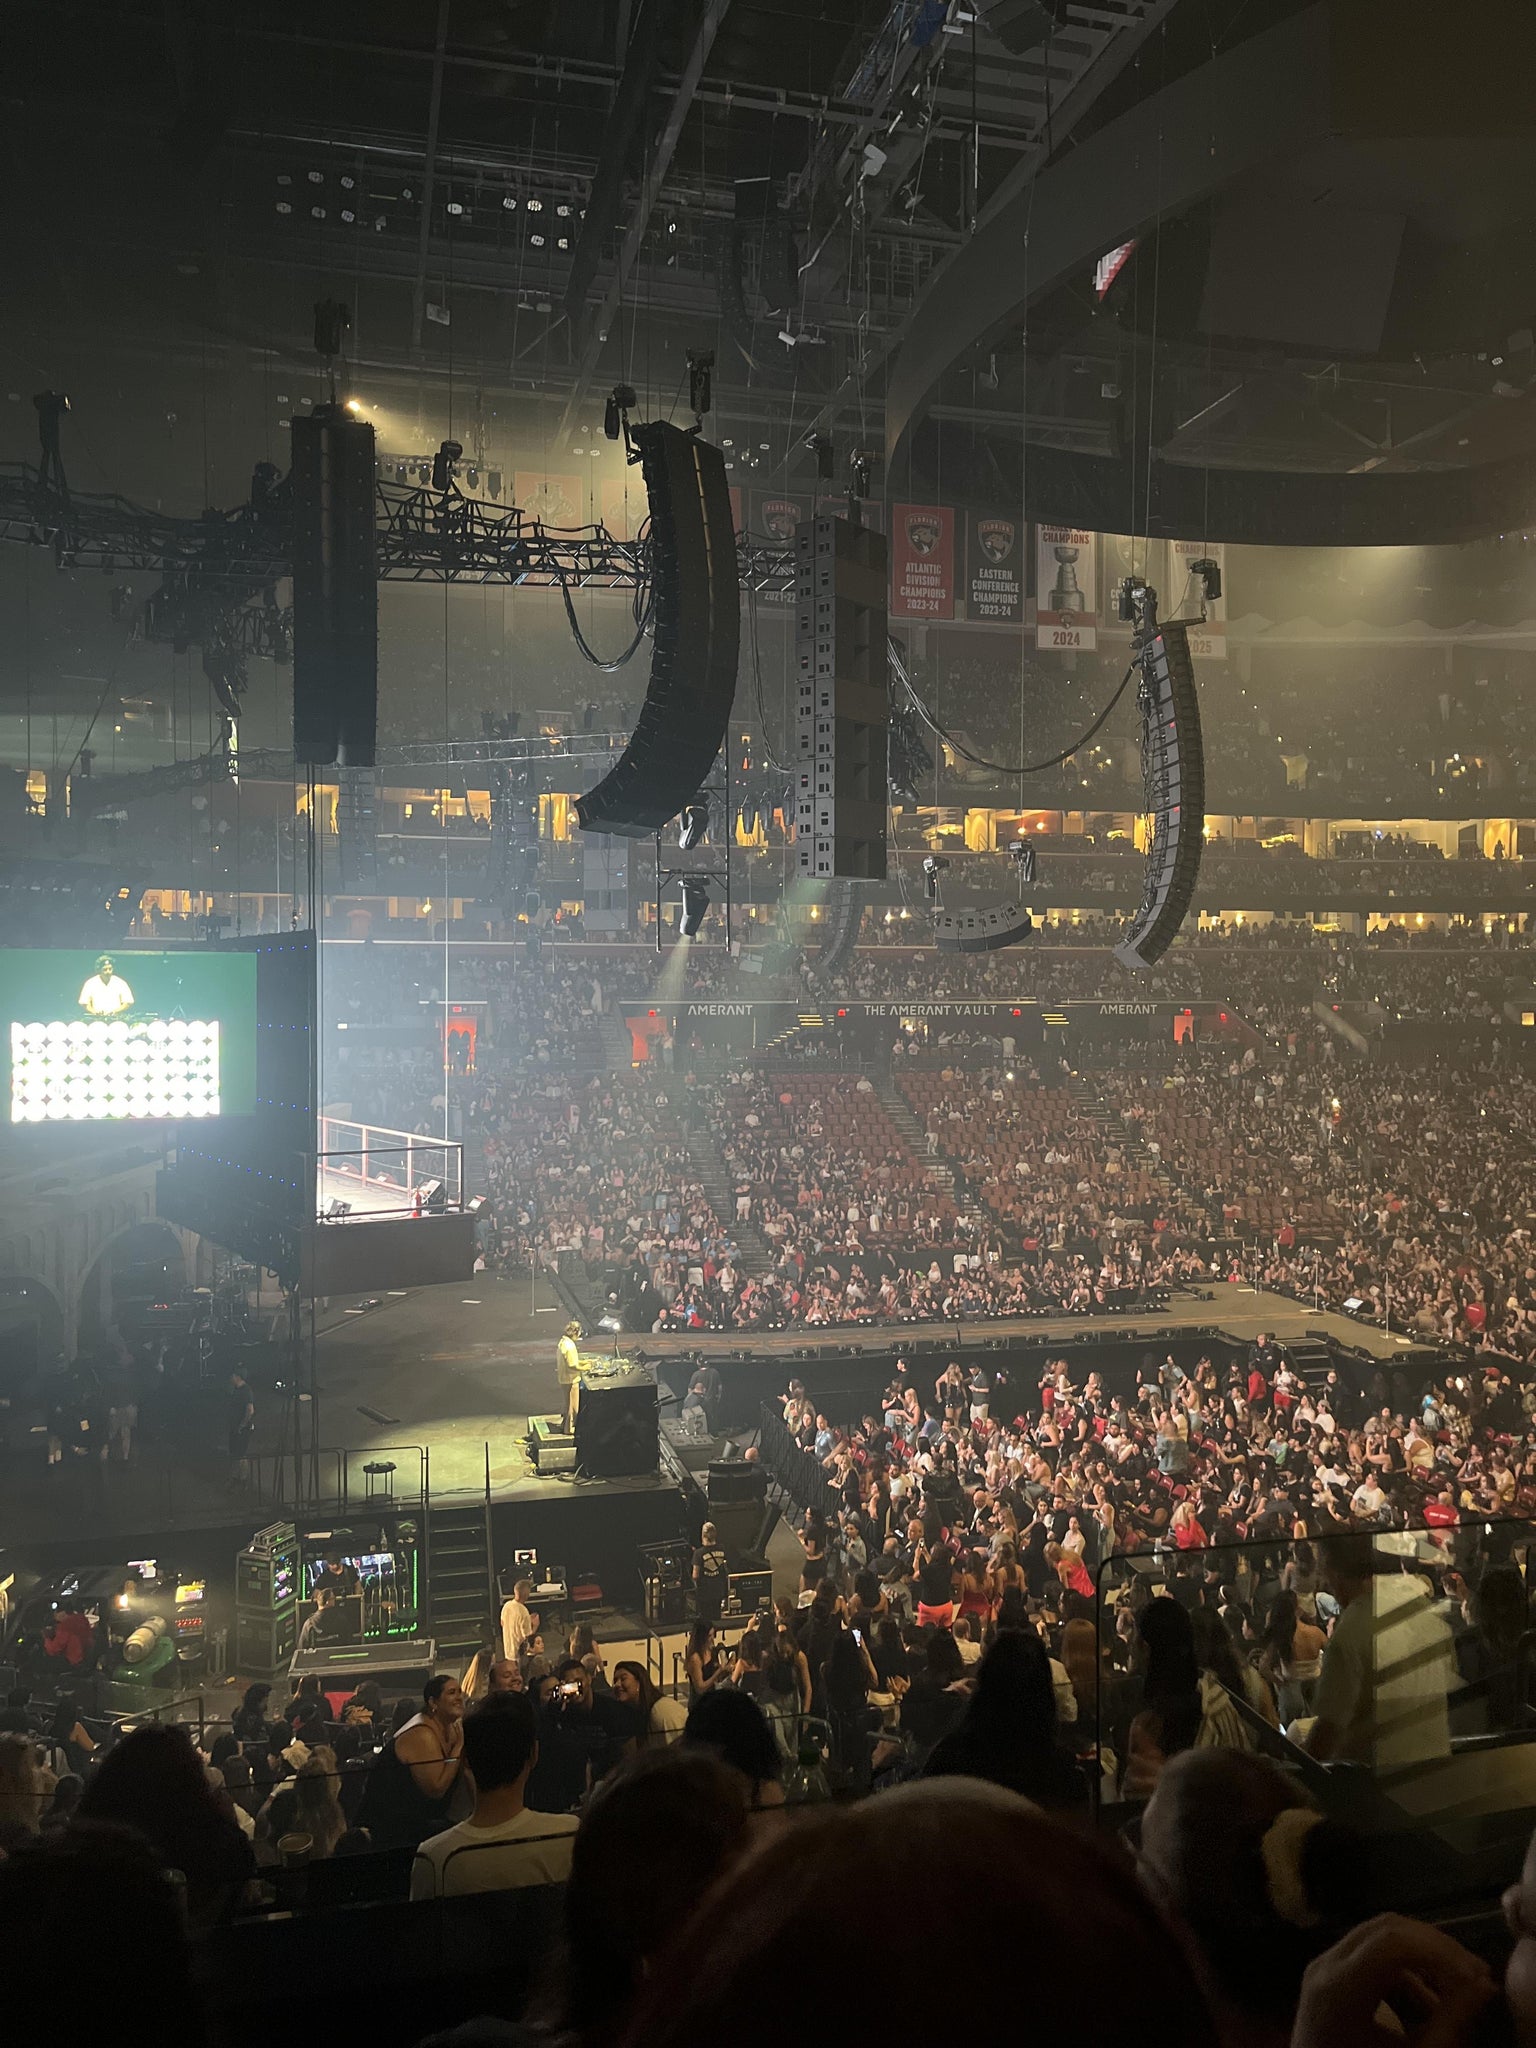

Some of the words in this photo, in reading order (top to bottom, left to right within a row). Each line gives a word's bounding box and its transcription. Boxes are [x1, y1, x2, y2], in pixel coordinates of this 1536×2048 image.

[1043, 532, 1090, 544] CHAMPIONS
[1175, 543, 1220, 557] CHAMPIONS
[905, 562, 942, 574] ATLANTIC
[979, 568, 1013, 580] EASTERN
[906, 574, 941, 587] DIVISION
[972, 580, 1019, 593] CONFERENCE
[764, 591, 796, 604] 2021-22
[900, 586, 946, 599] CHAMPIONS
[973, 592, 1018, 604] CHAMPIONS
[907, 599, 939, 611] 2023-24
[980, 604, 1011, 616] 2023-24
[1053, 631, 1081, 646] 2024
[687, 1004, 753, 1016] AMERANT
[864, 1005, 886, 1016] THE
[890, 1005, 951, 1016] AMERANT
[955, 1005, 997, 1016] VAULT
[1100, 1004, 1158, 1015] AMERANT
